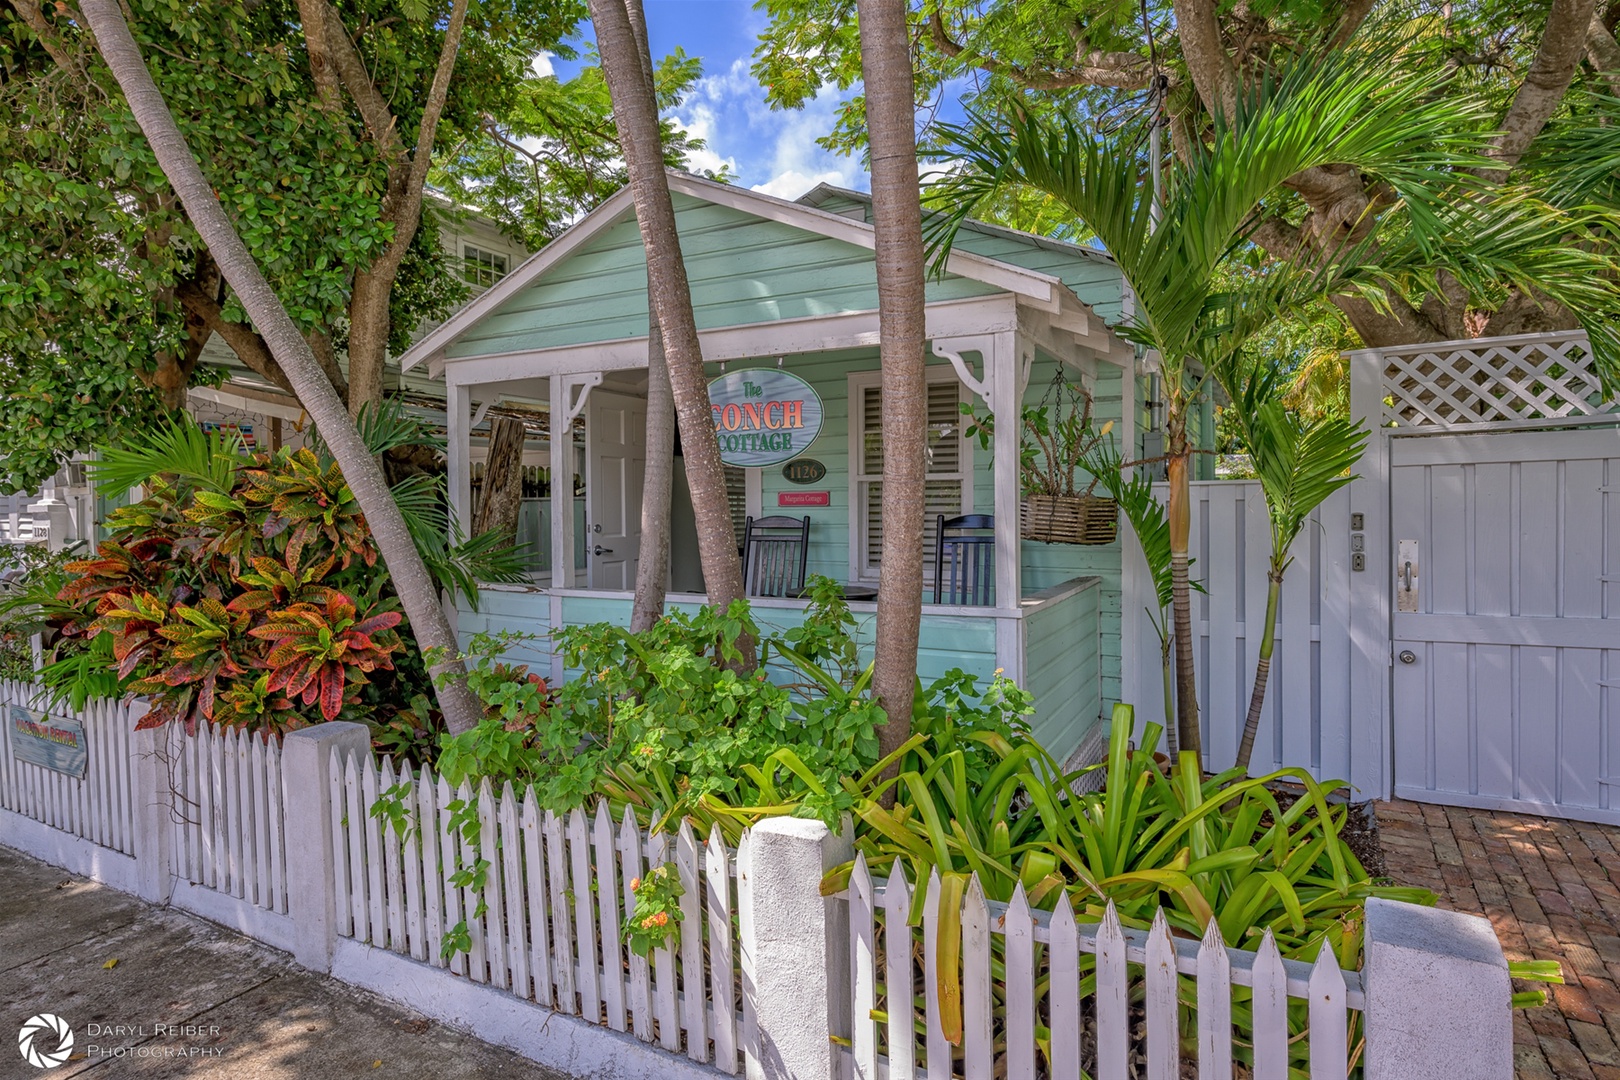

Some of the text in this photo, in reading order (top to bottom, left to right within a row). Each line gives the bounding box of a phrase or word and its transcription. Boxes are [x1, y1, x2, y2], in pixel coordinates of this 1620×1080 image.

[743, 381, 763, 398] The
[717, 432, 793, 453] COTTAGE
[790, 464, 818, 479] 1126
[784, 494, 822, 503] Margarita Cottage
[15, 717, 78, 749] VACATION RENTAL
